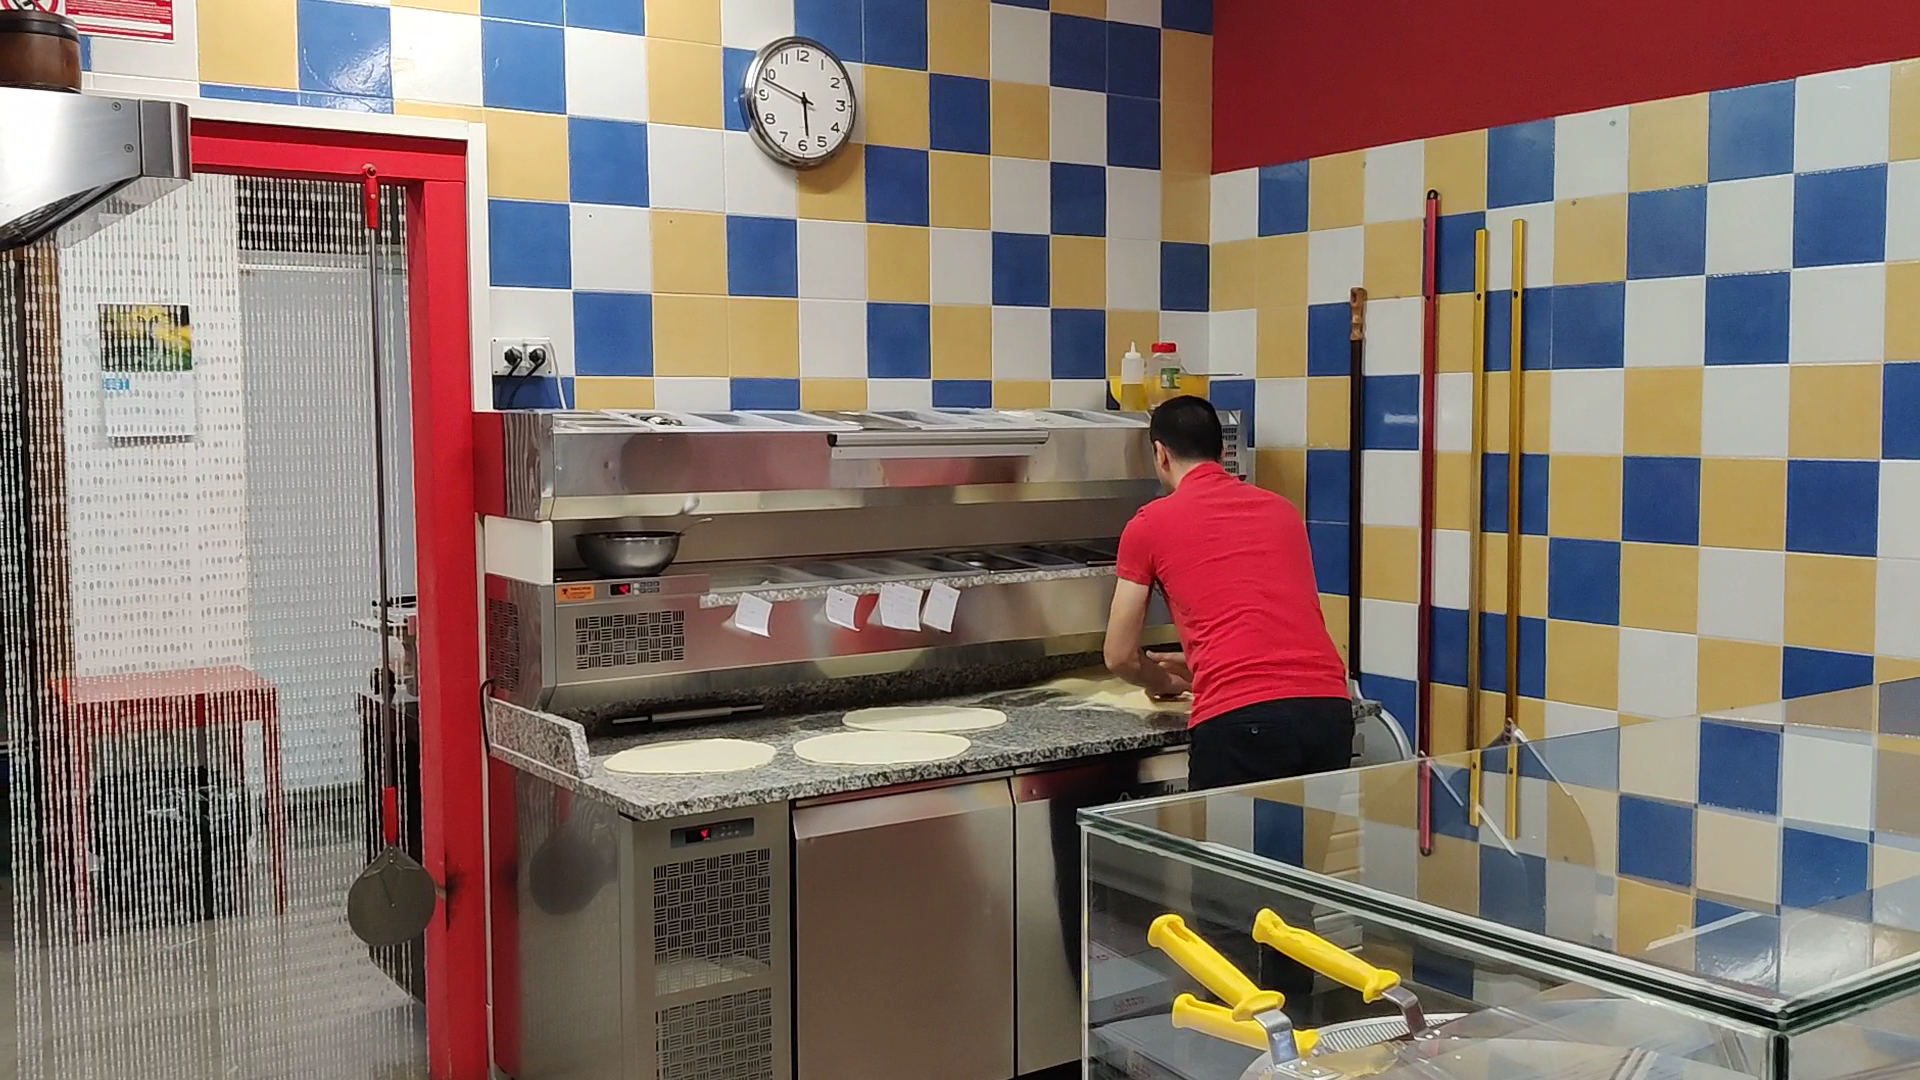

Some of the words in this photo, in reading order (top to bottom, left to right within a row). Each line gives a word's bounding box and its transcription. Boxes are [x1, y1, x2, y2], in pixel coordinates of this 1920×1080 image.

[780, 52, 789, 65] 11
[796, 49, 810, 62] 12
[821, 59, 824, 70] 1
[765, 68, 776, 80] 10
[830, 77, 840, 89] 2
[759, 89, 769, 101] 9
[835, 100, 846, 112] 3
[764, 113, 776, 125] 8
[830, 122, 840, 134] 4
[779, 131, 788, 143] 7
[817, 136, 827, 148] 5
[798, 140, 808, 152] 6
